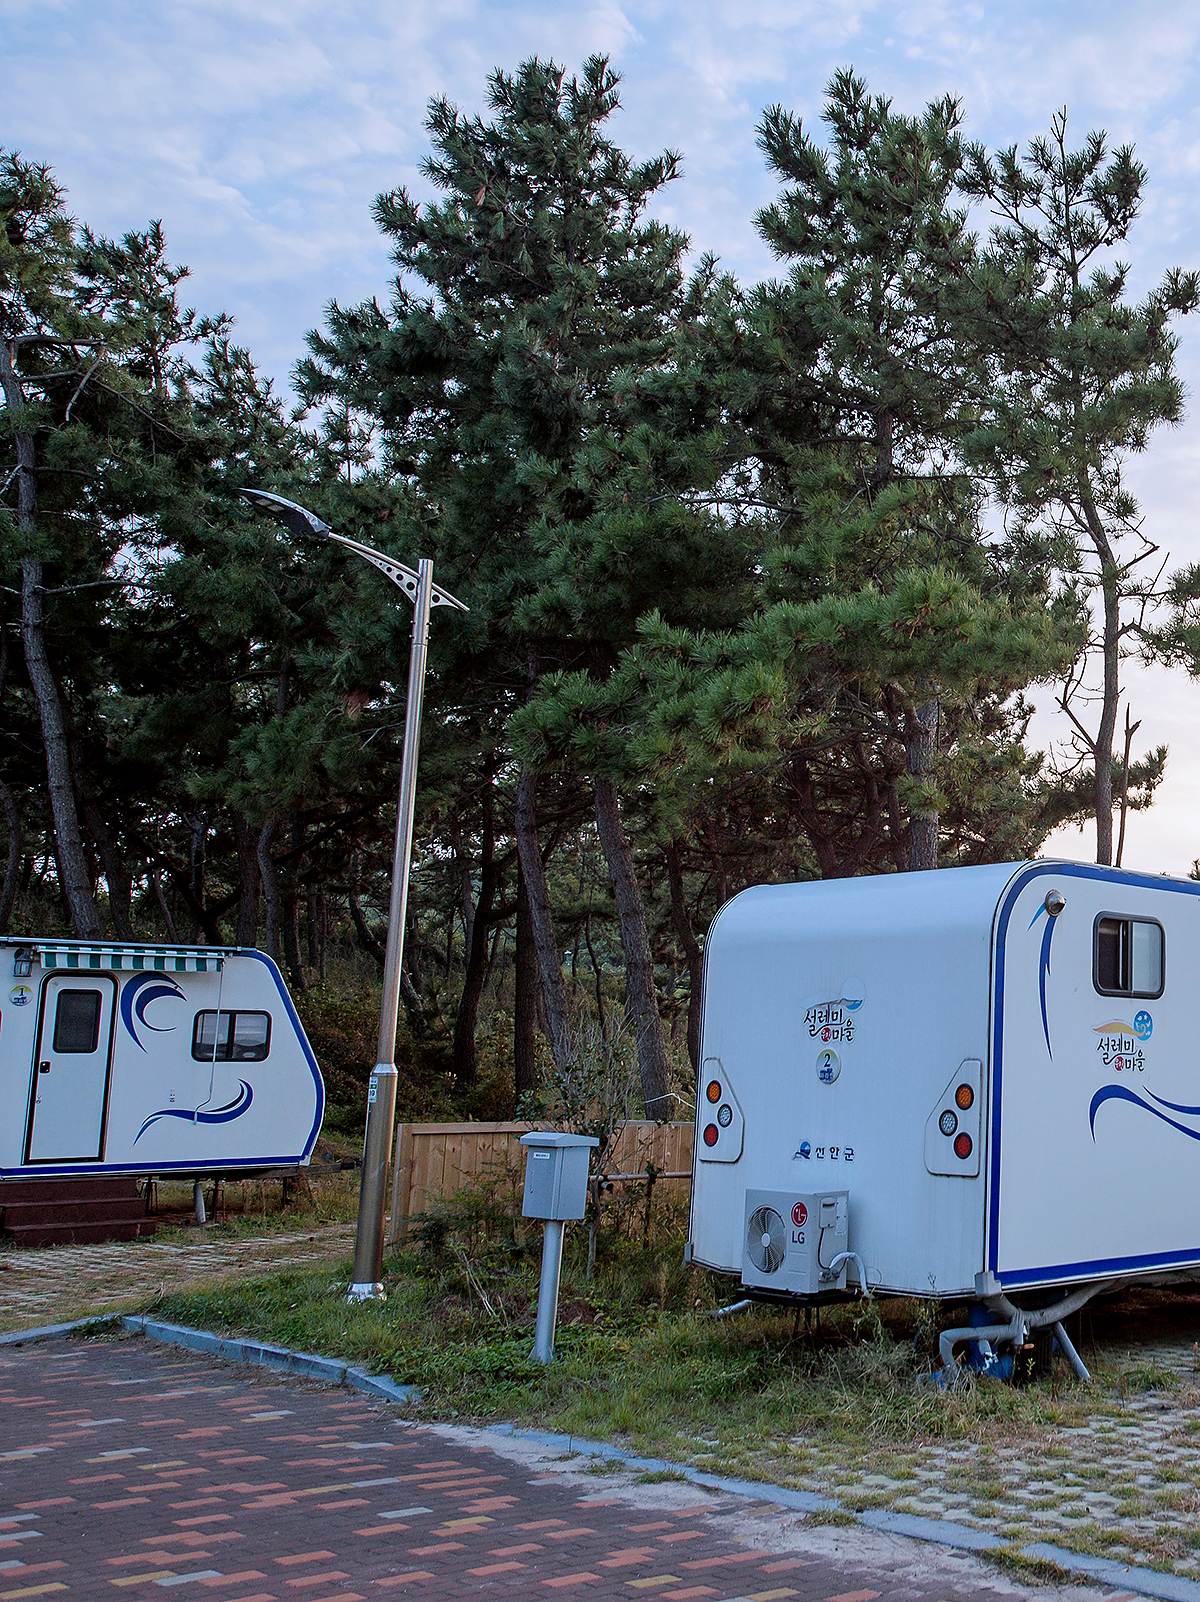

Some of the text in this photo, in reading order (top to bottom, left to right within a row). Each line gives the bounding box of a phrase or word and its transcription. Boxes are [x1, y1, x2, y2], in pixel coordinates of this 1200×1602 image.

[832, 1018, 855, 1042] 마을
[824, 1053, 831, 1067] 2
[1125, 1049, 1146, 1072] 마을
[815, 1146, 855, 1162] 신안군
[792, 1230, 805, 1244] LG
